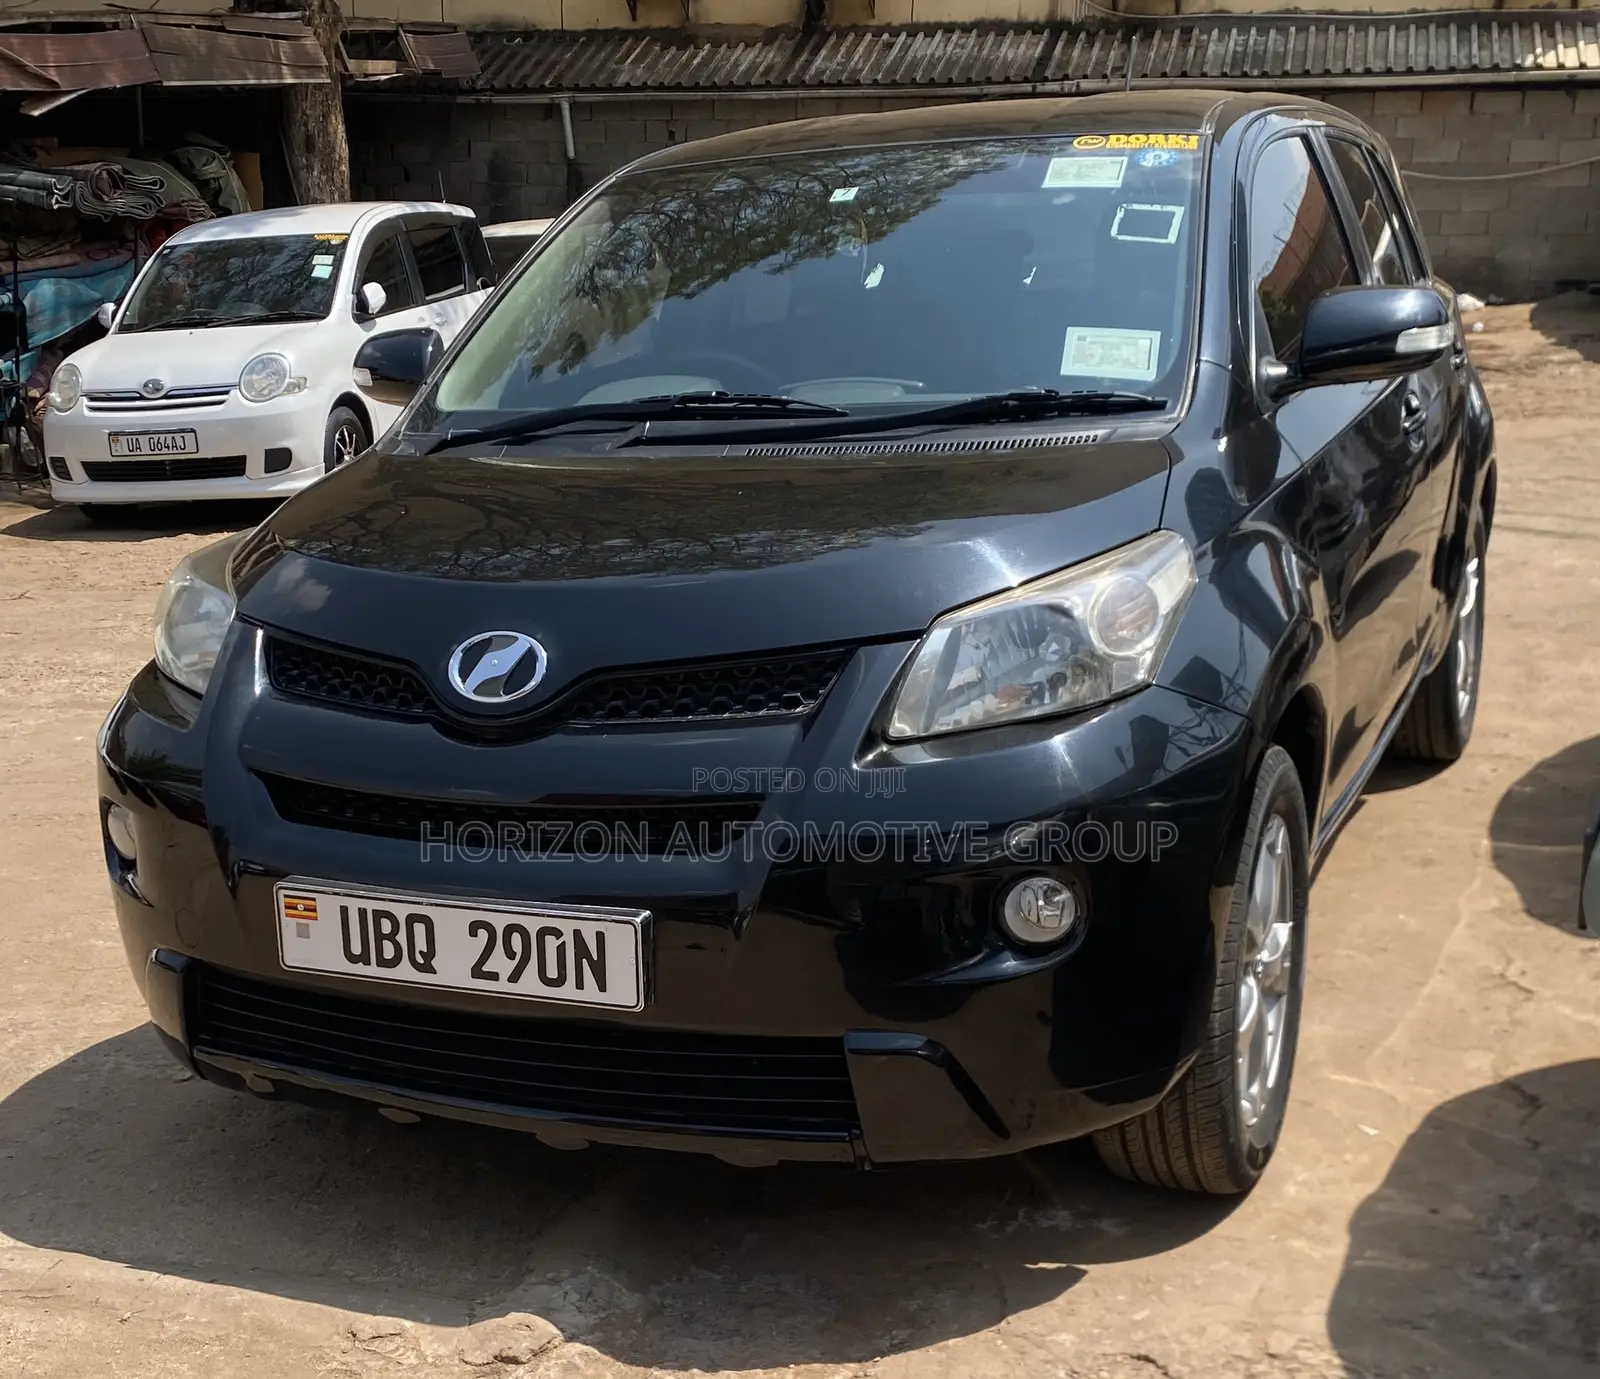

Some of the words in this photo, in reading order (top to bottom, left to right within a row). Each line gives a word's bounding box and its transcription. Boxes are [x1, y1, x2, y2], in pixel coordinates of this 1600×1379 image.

[126, 437, 142, 453] UA
[148, 435, 187, 452] 064AJ
[339, 905, 437, 975] UBQ
[468, 919, 607, 993] 290N
